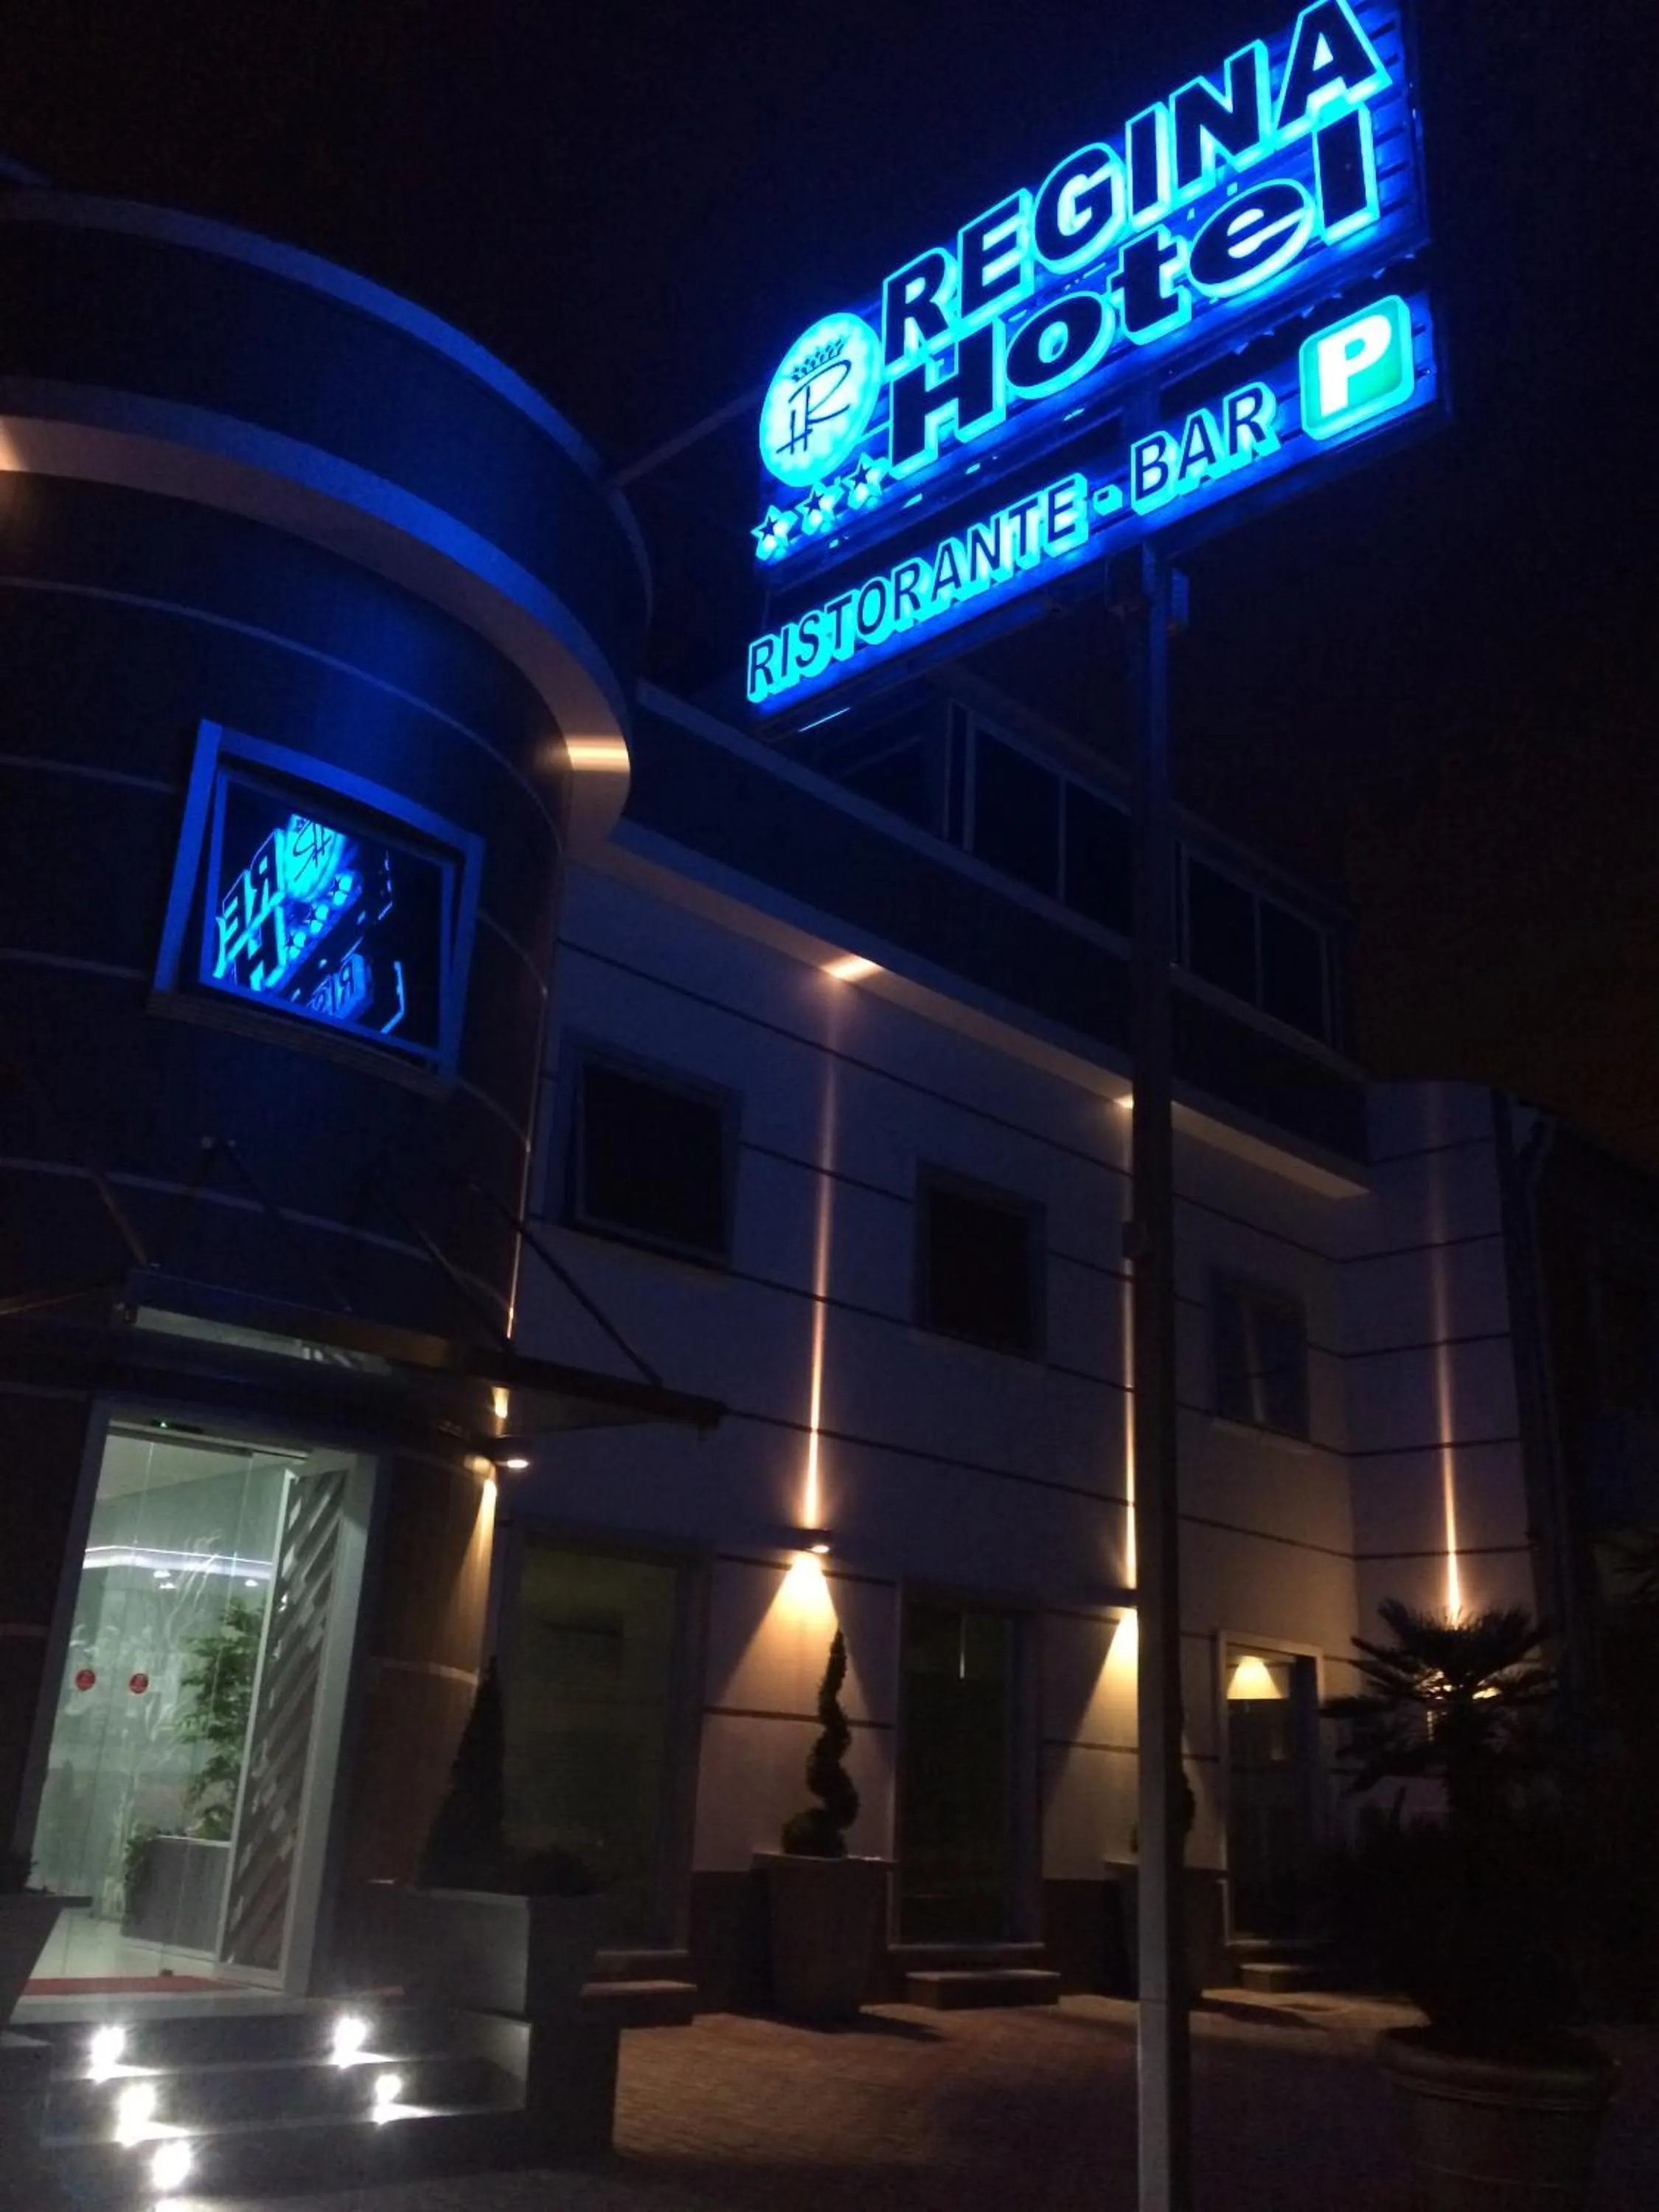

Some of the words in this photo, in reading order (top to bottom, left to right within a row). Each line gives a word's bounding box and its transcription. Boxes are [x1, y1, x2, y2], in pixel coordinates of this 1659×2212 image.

[880, 0, 1392, 376] REGINA
[885, 103, 1379, 476] Hotel
[1318, 315, 1392, 414] P
[746, 474, 1088, 702] RISTORANTE
[1130, 382, 1280, 516] BAR
